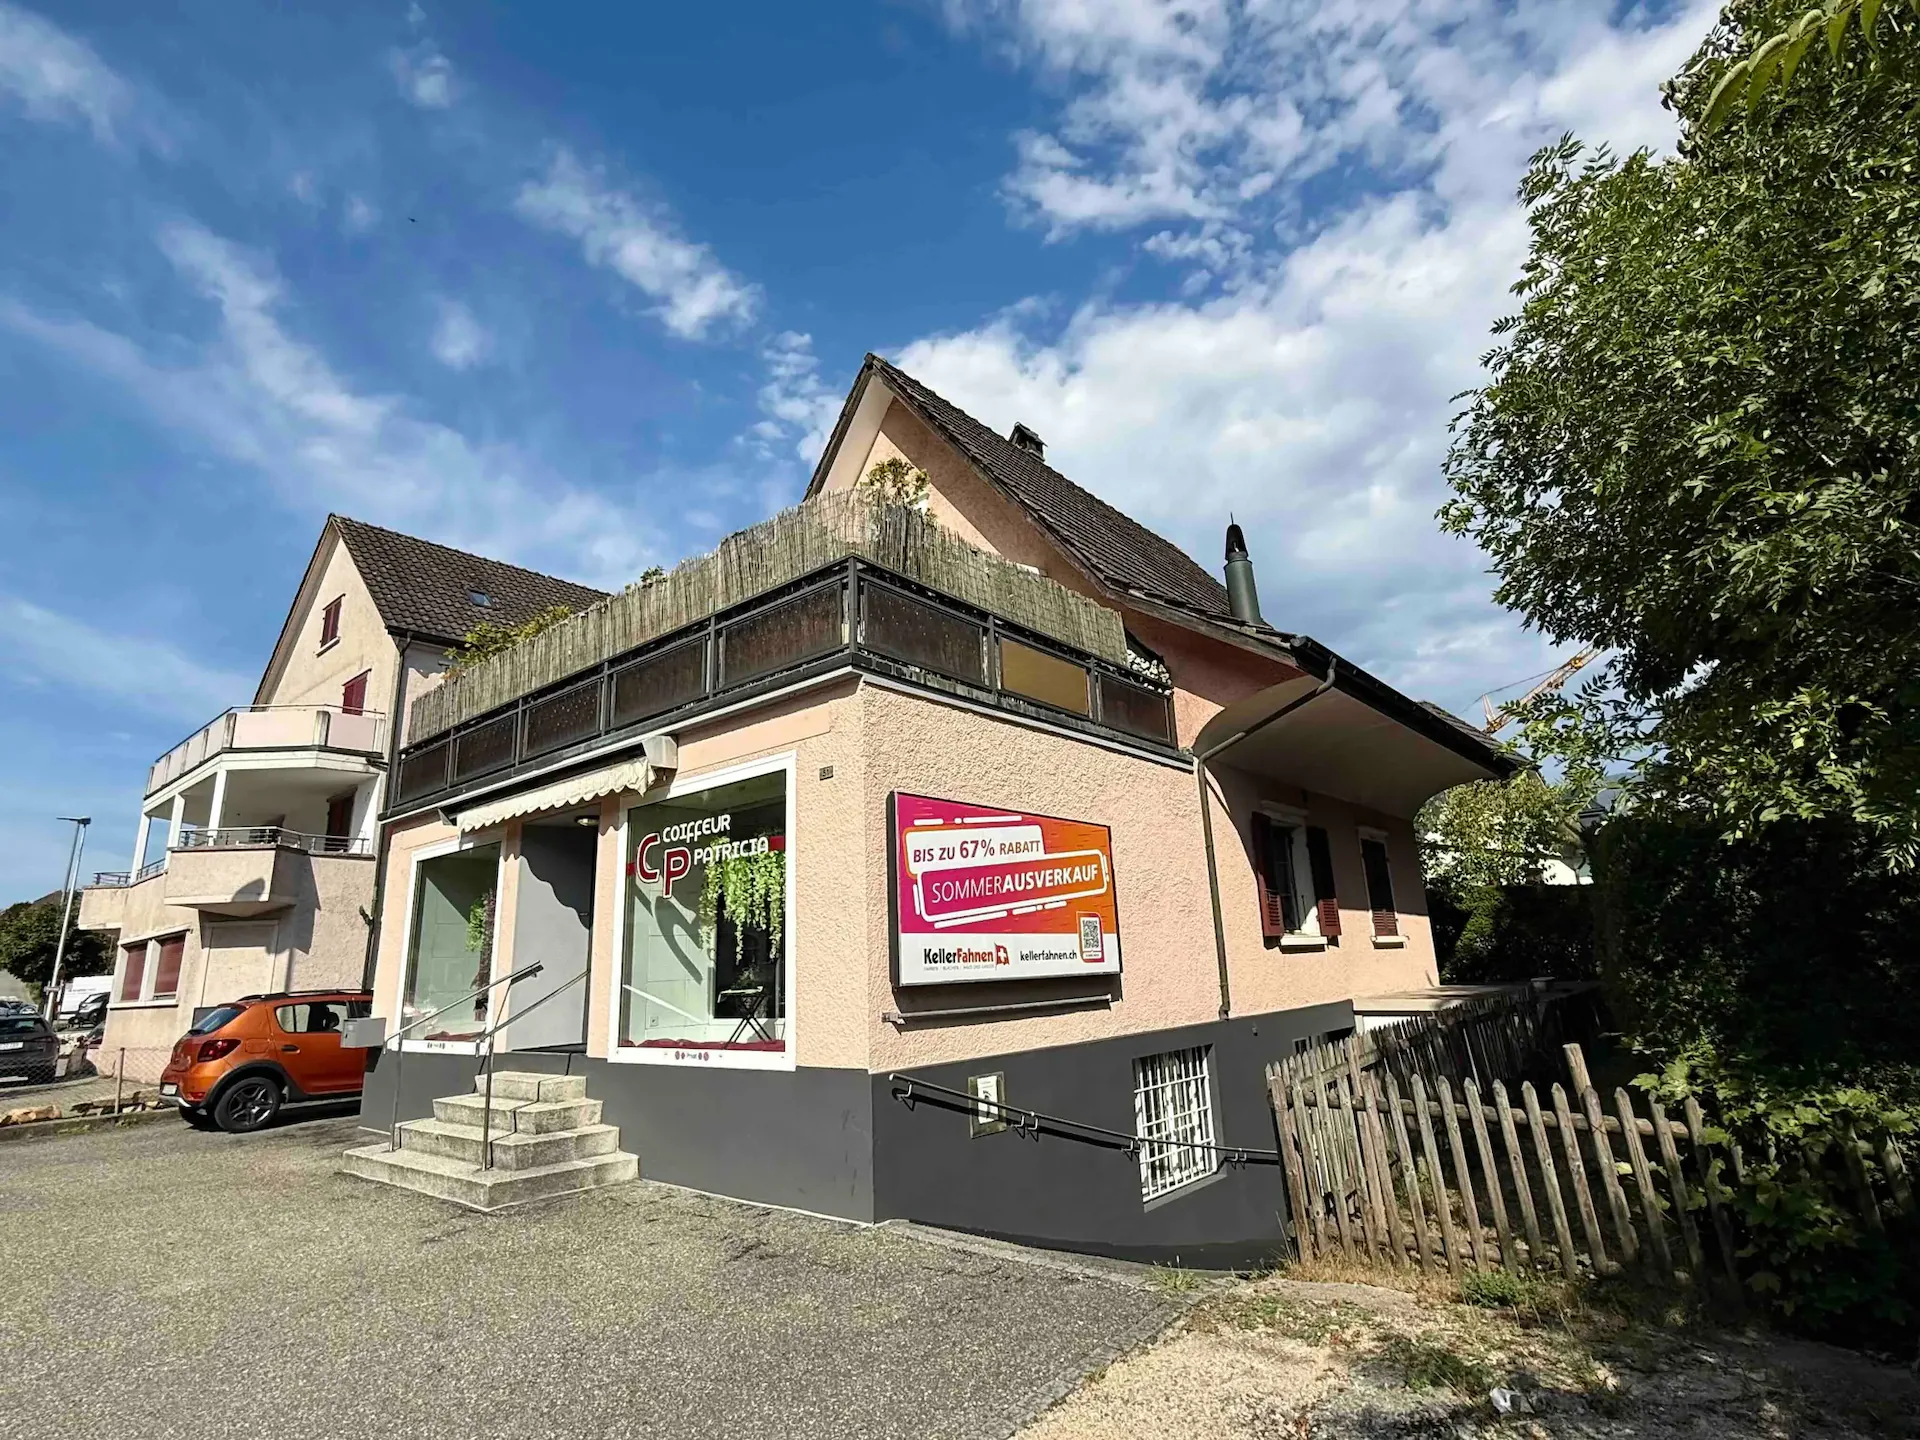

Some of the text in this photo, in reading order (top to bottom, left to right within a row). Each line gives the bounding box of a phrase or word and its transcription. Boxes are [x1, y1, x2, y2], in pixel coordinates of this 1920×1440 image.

[662, 814, 731, 843] COIFFEUR
[693, 836, 769, 865] PATRICIA
[913, 838, 1041, 863] BIS ZU 67% RABATT
[931, 864, 1099, 904] SOMMERAUSVERKAUF
[923, 948, 994, 965] KellerFahnen
[1020, 949, 1078, 962] kellerfahnen.ch
